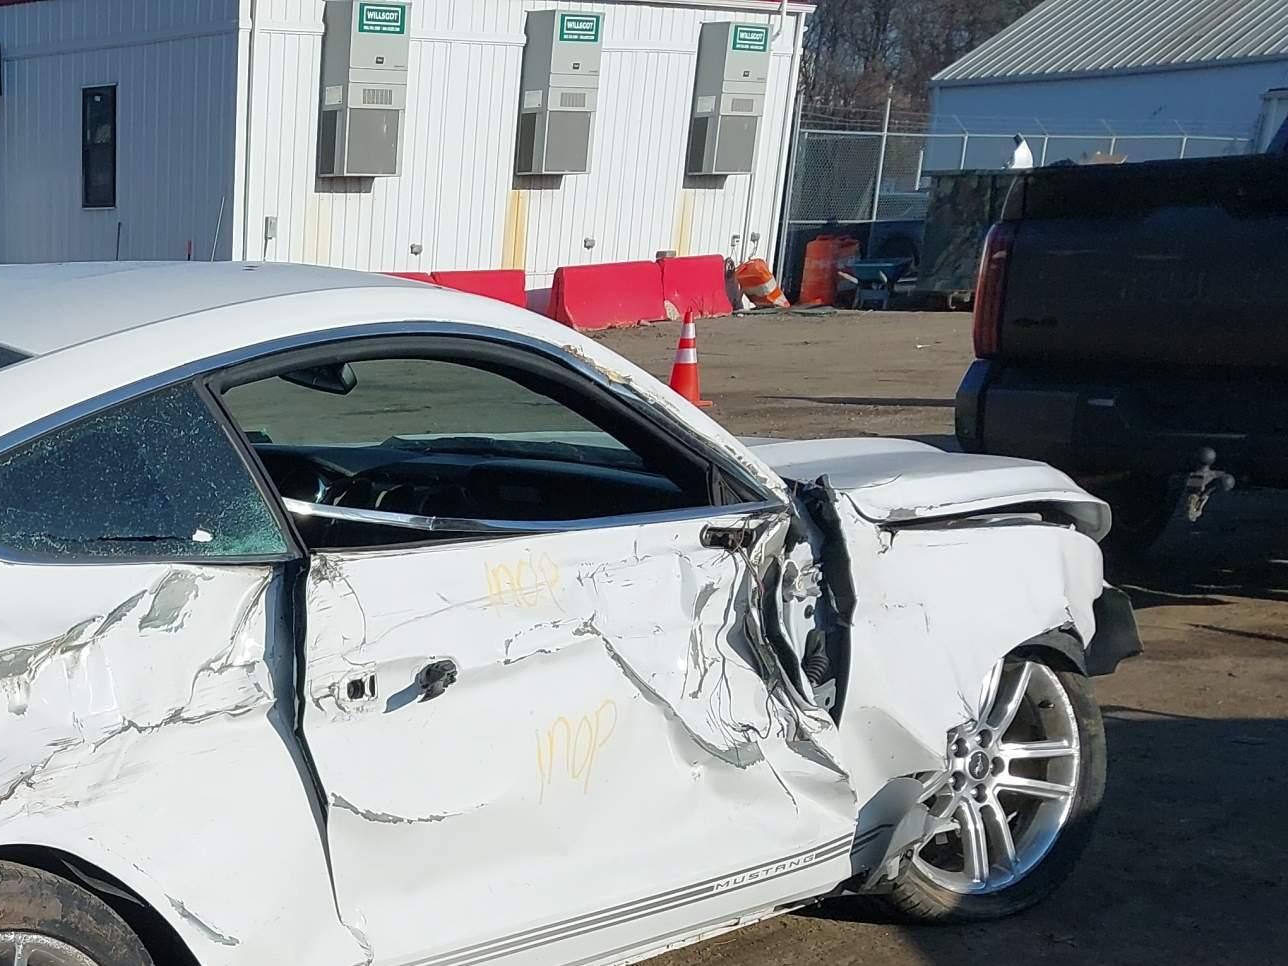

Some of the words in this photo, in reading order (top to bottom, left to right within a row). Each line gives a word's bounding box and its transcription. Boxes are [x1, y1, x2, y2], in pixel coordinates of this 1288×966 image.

[366, 10, 399, 21] WILLSCOT
[566, 20, 594, 30] WILLSCOT
[715, 853, 815, 891] MUSTANG
